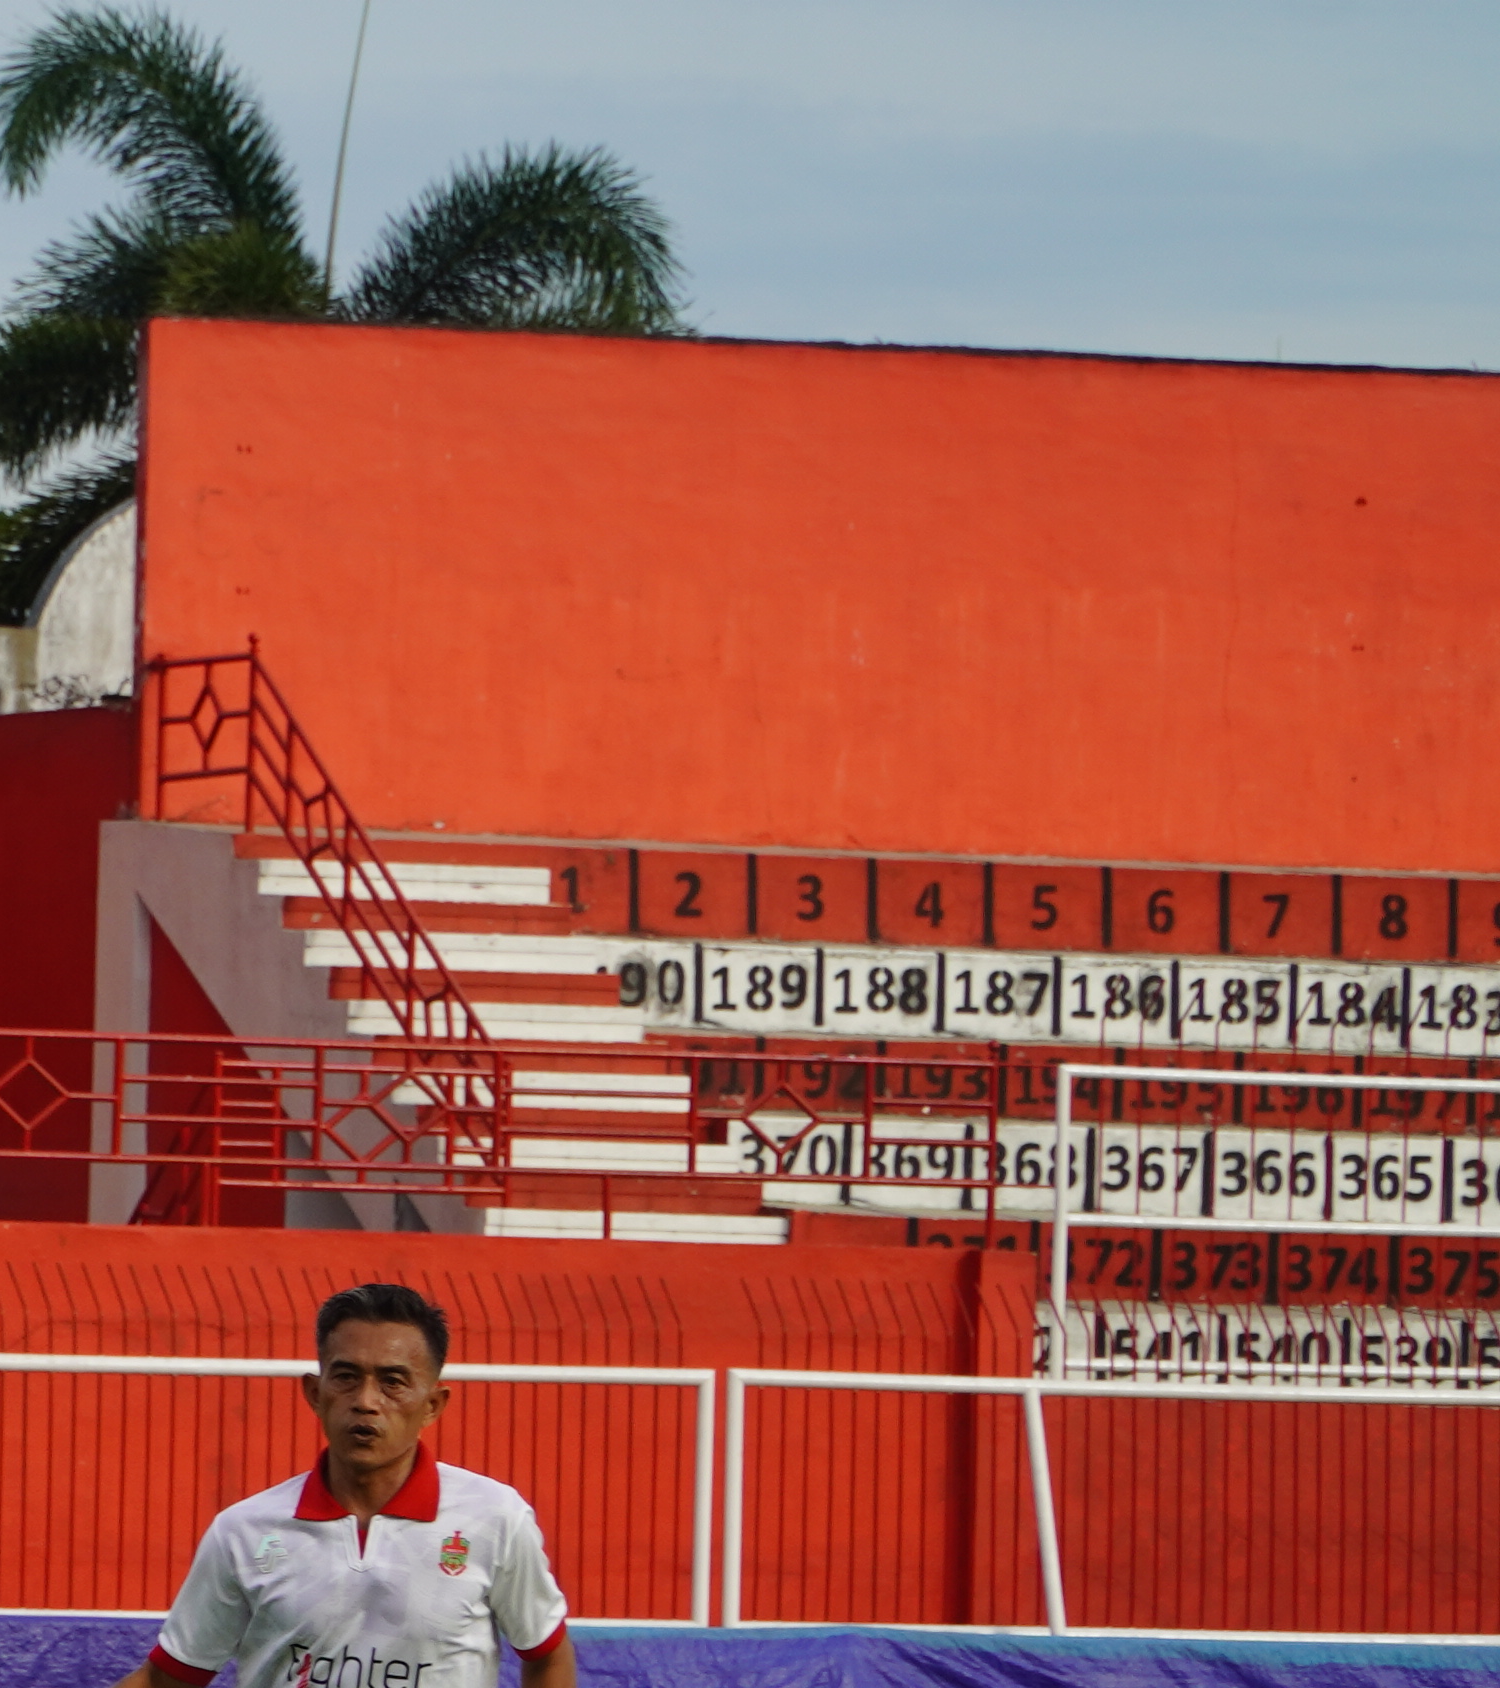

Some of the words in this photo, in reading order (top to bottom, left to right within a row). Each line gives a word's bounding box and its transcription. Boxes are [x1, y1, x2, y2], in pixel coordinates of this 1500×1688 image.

[675, 872, 701, 917] 2
[798, 875, 823, 920] 3
[915, 883, 943, 927] 4
[1032, 885, 1057, 930] 5
[1148, 890, 1174, 933] 6
[1263, 894, 1289, 937] 7
[1381, 895, 1406, 938] 8
[713, 964, 807, 1010] 189
[835, 967, 928, 1015] 188
[954, 970, 1050, 1018] 187
[1072, 974, 1165, 1022] 186
[1190, 978, 1280, 1026] 185
[1100, 1145, 1198, 1192] 367
[1221, 1149, 1315, 1197] 366
[1340, 1154, 1432, 1202] 365
[1169, 1242, 1261, 1291] 373
[1286, 1245, 1379, 1294] 374
